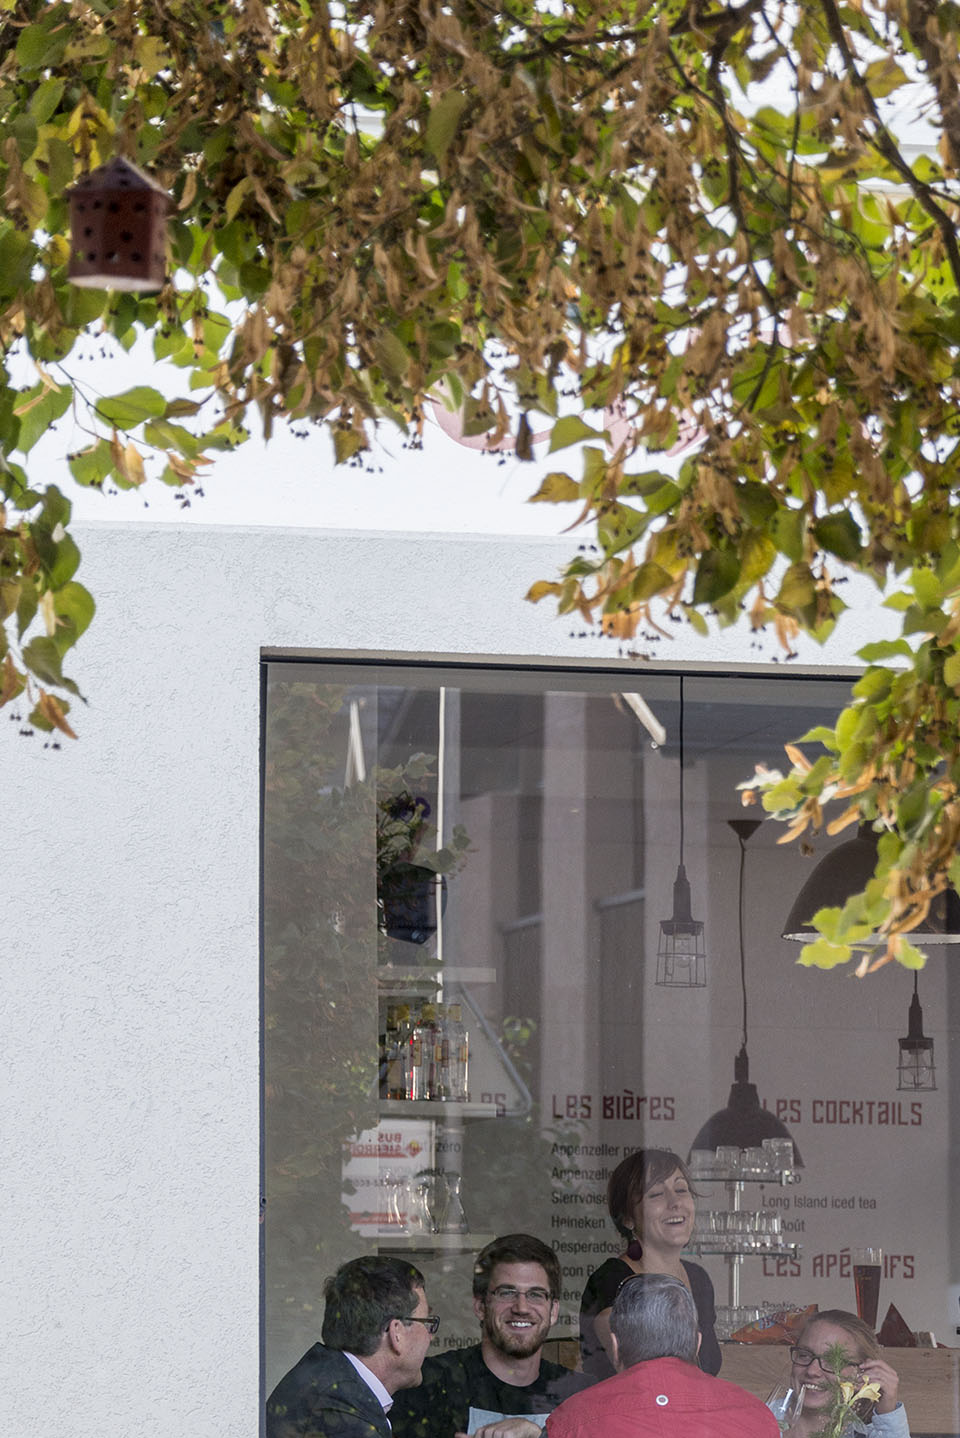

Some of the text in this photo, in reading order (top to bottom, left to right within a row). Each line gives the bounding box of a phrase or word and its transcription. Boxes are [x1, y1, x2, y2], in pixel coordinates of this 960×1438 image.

[552, 1143, 619, 1158] Appenzeller
[761, 1195, 877, 1210] Long Island iced tea
[552, 1215, 606, 1229] Heineken
[552, 1240, 620, 1255] Desperados
